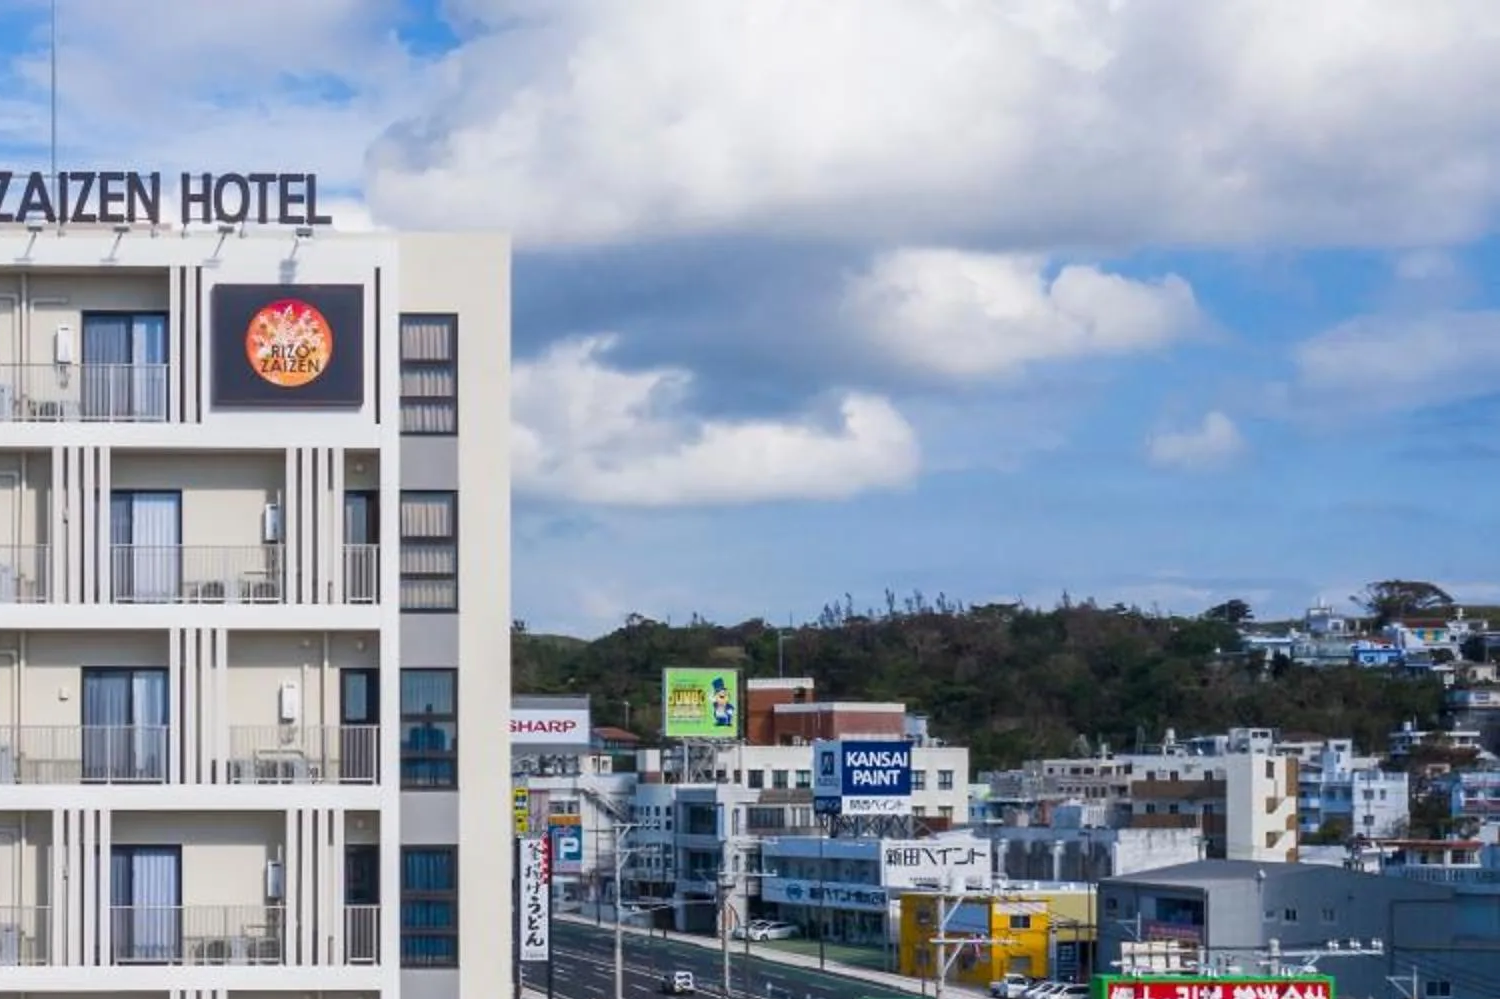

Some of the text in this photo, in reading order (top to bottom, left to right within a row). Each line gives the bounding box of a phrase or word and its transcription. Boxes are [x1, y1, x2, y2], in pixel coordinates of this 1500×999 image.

[181, 172, 332, 225] HOTEL
[271, 344, 309, 358] RIZO
[261, 359, 320, 373] ZAIZEN
[509, 719, 577, 733] SHARP
[846, 751, 908, 767] KANSAI
[852, 769, 900, 785] PAINT
[560, 837, 579, 859] P
